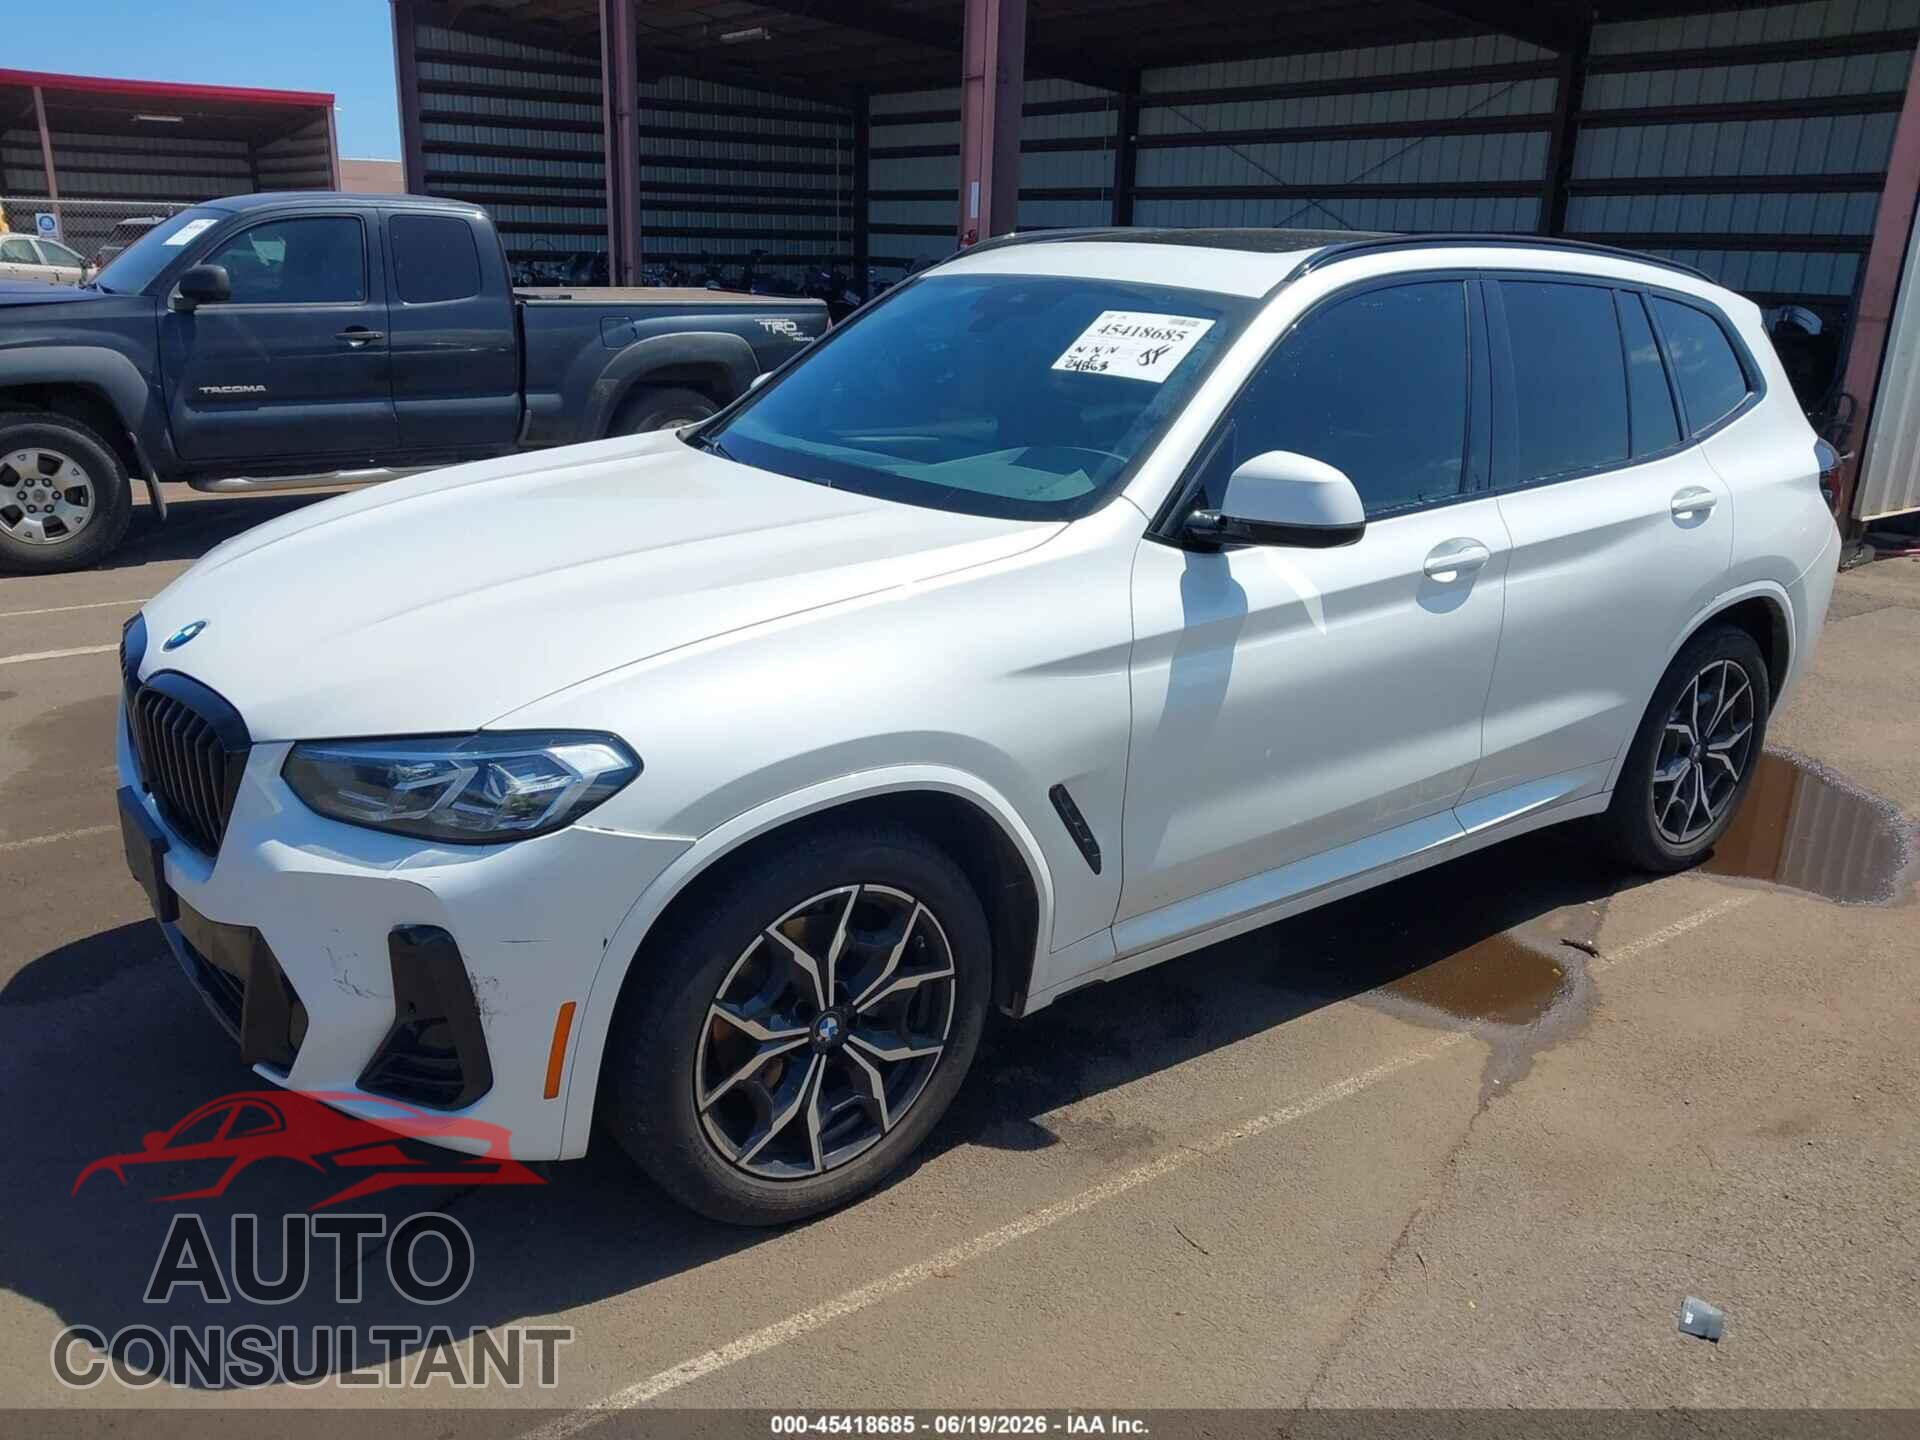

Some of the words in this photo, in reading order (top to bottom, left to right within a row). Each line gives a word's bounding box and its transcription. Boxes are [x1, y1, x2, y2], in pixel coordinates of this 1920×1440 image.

[759, 321, 797, 335] TRD
[1098, 323, 1189, 342] 45418685
[198, 385, 267, 394] TACOMA
